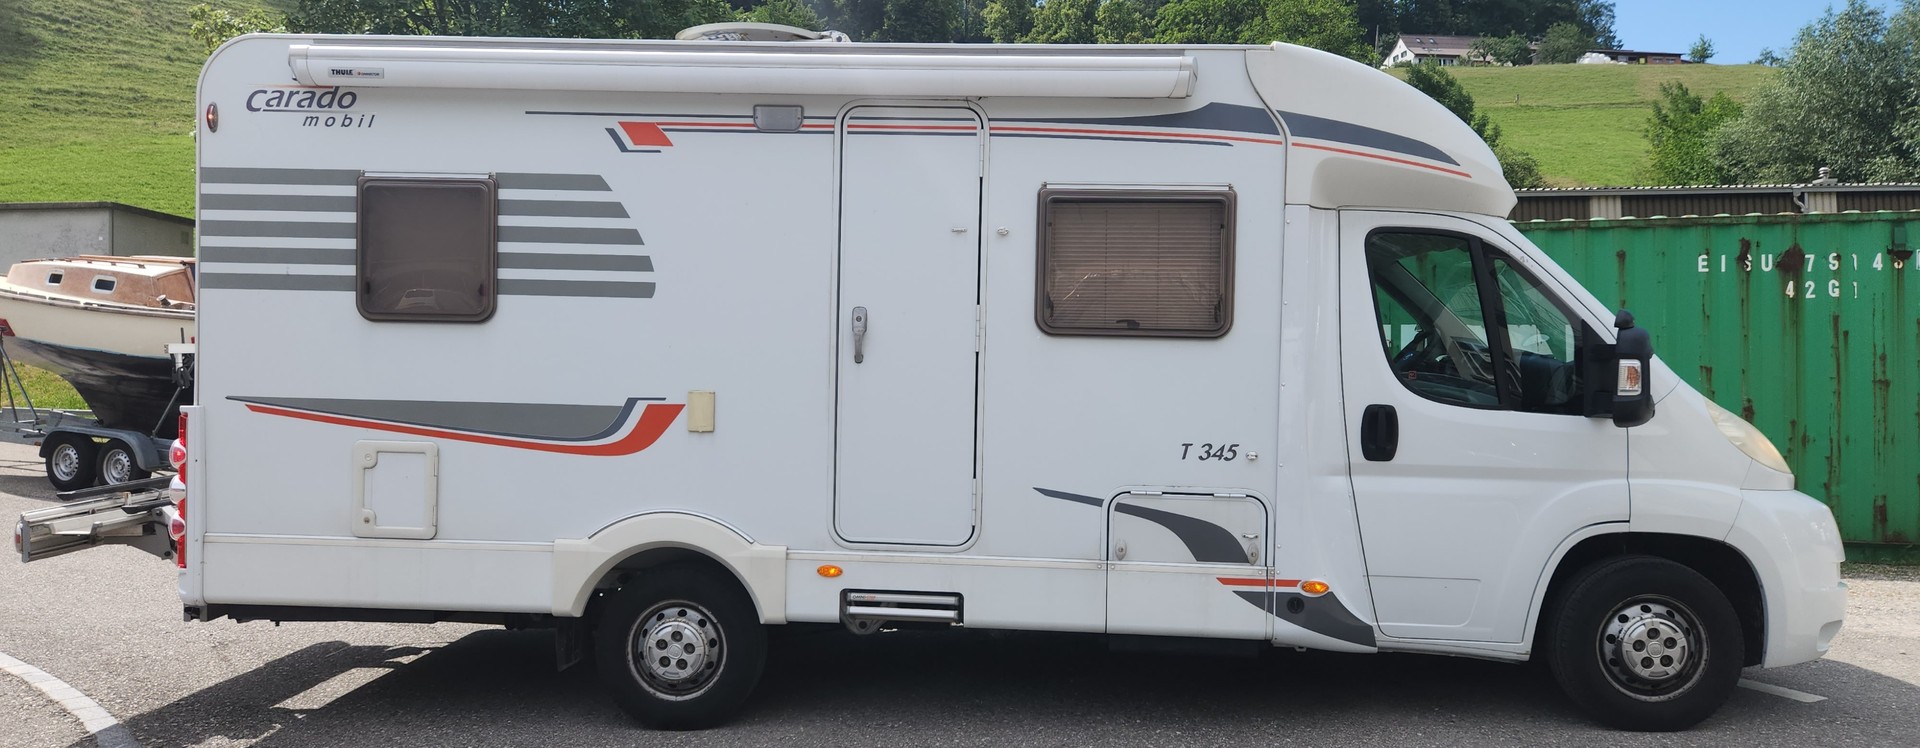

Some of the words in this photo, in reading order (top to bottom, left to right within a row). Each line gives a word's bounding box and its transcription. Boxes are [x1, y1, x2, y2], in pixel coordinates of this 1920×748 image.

[302, 114, 376, 128] mobil
[1785, 279, 1859, 299] 42G1
[1181, 443, 1194, 460] T
[1198, 443, 1240, 461] 345
